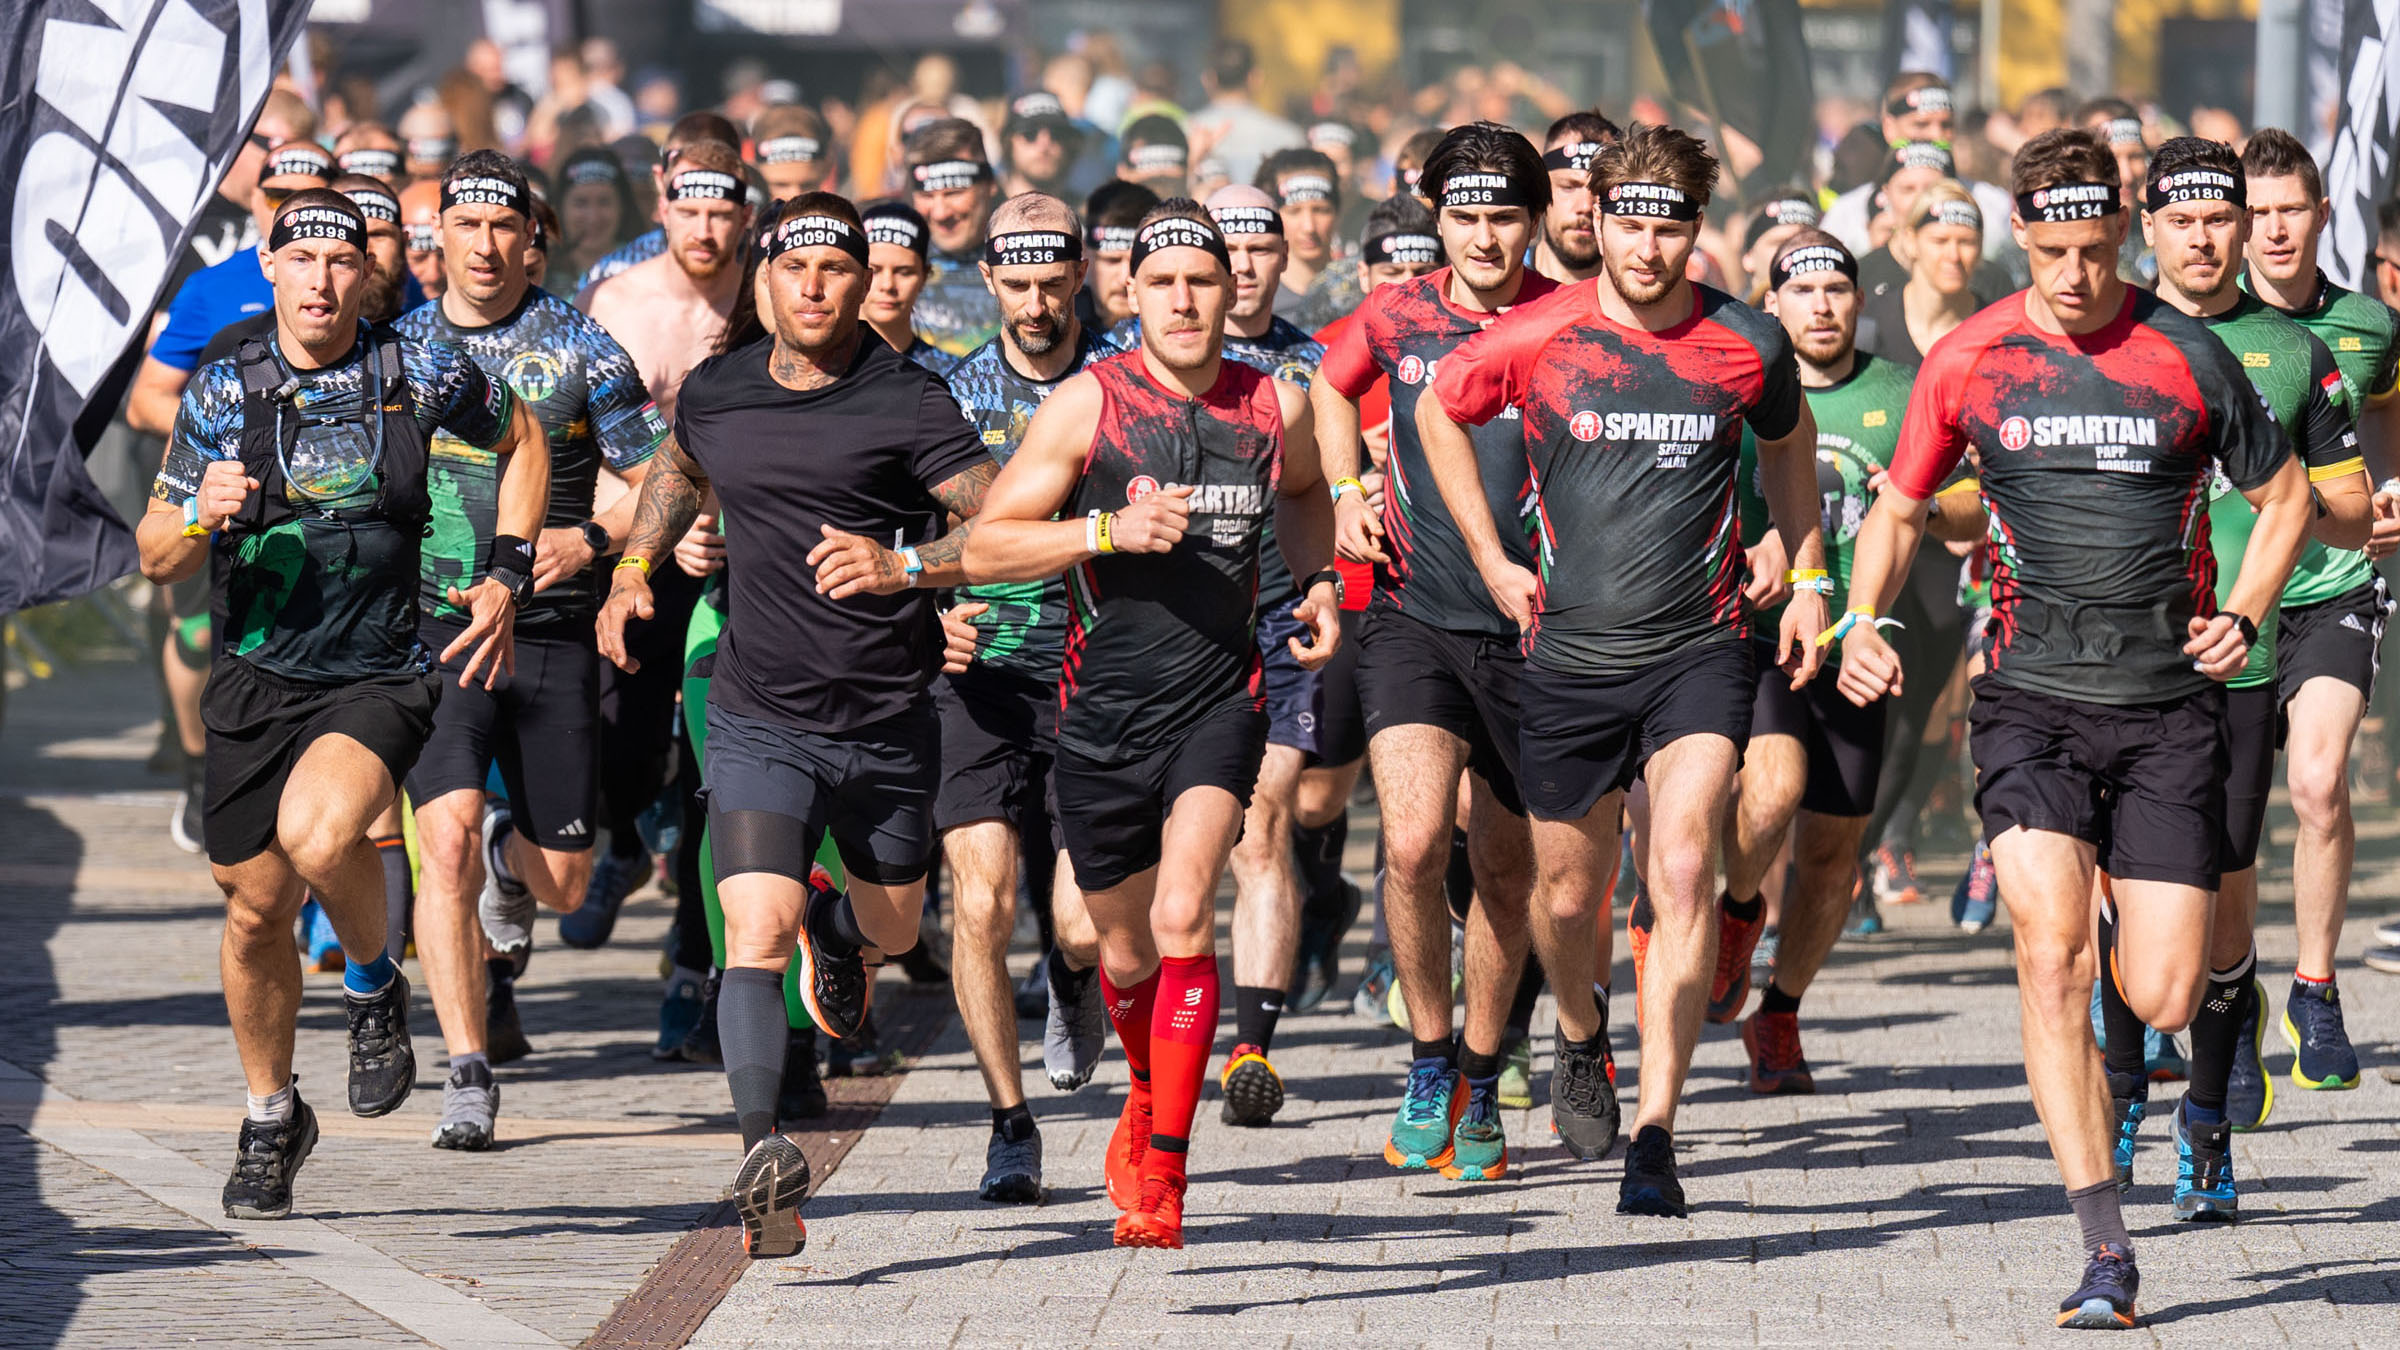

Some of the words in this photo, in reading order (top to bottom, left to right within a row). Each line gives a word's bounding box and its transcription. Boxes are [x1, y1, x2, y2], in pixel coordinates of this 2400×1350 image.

[461, 178, 517, 197] SPARTAN
[1448, 175, 1507, 190] SPARTAN
[2173, 172, 2234, 189] SPARTAN
[456, 191, 508, 206] 20304
[1446, 190, 1493, 206] 20936
[1621, 185, 1684, 203] SPARTAN
[2049, 186, 2109, 204] SPARTAN
[2168, 188, 2224, 203] 20180
[1221, 208, 1274, 222] SPARTAN
[1615, 201, 1671, 216] 21383
[2043, 203, 2103, 222] 21134
[300, 209, 357, 230] SPARTAN
[788, 216, 849, 236] SPARTAN
[292, 224, 347, 241] 21398
[1153, 218, 1214, 240] SPARTAN
[784, 229, 836, 251] 20090
[1006, 234, 1065, 250] SPARTAN
[1147, 231, 1203, 252] 20163
[1001, 251, 1054, 265] 21336
[1791, 246, 1844, 264] SPARTAN
[2339, 337, 2361, 351] 575
[2242, 352, 2271, 368] 575
[648, 417, 668, 436] HU
[1605, 413, 1716, 441] SPARTAN
[2033, 415, 2157, 447] SPARTAN
[983, 429, 1006, 445] 575
[1657, 442, 1700, 456] SZÉKELY
[2095, 445, 2128, 459] PAPP
[1656, 456, 1688, 469] ZALÁN
[2096, 460, 2151, 473] NORBERT
[1164, 482, 1262, 515] ARTAN
